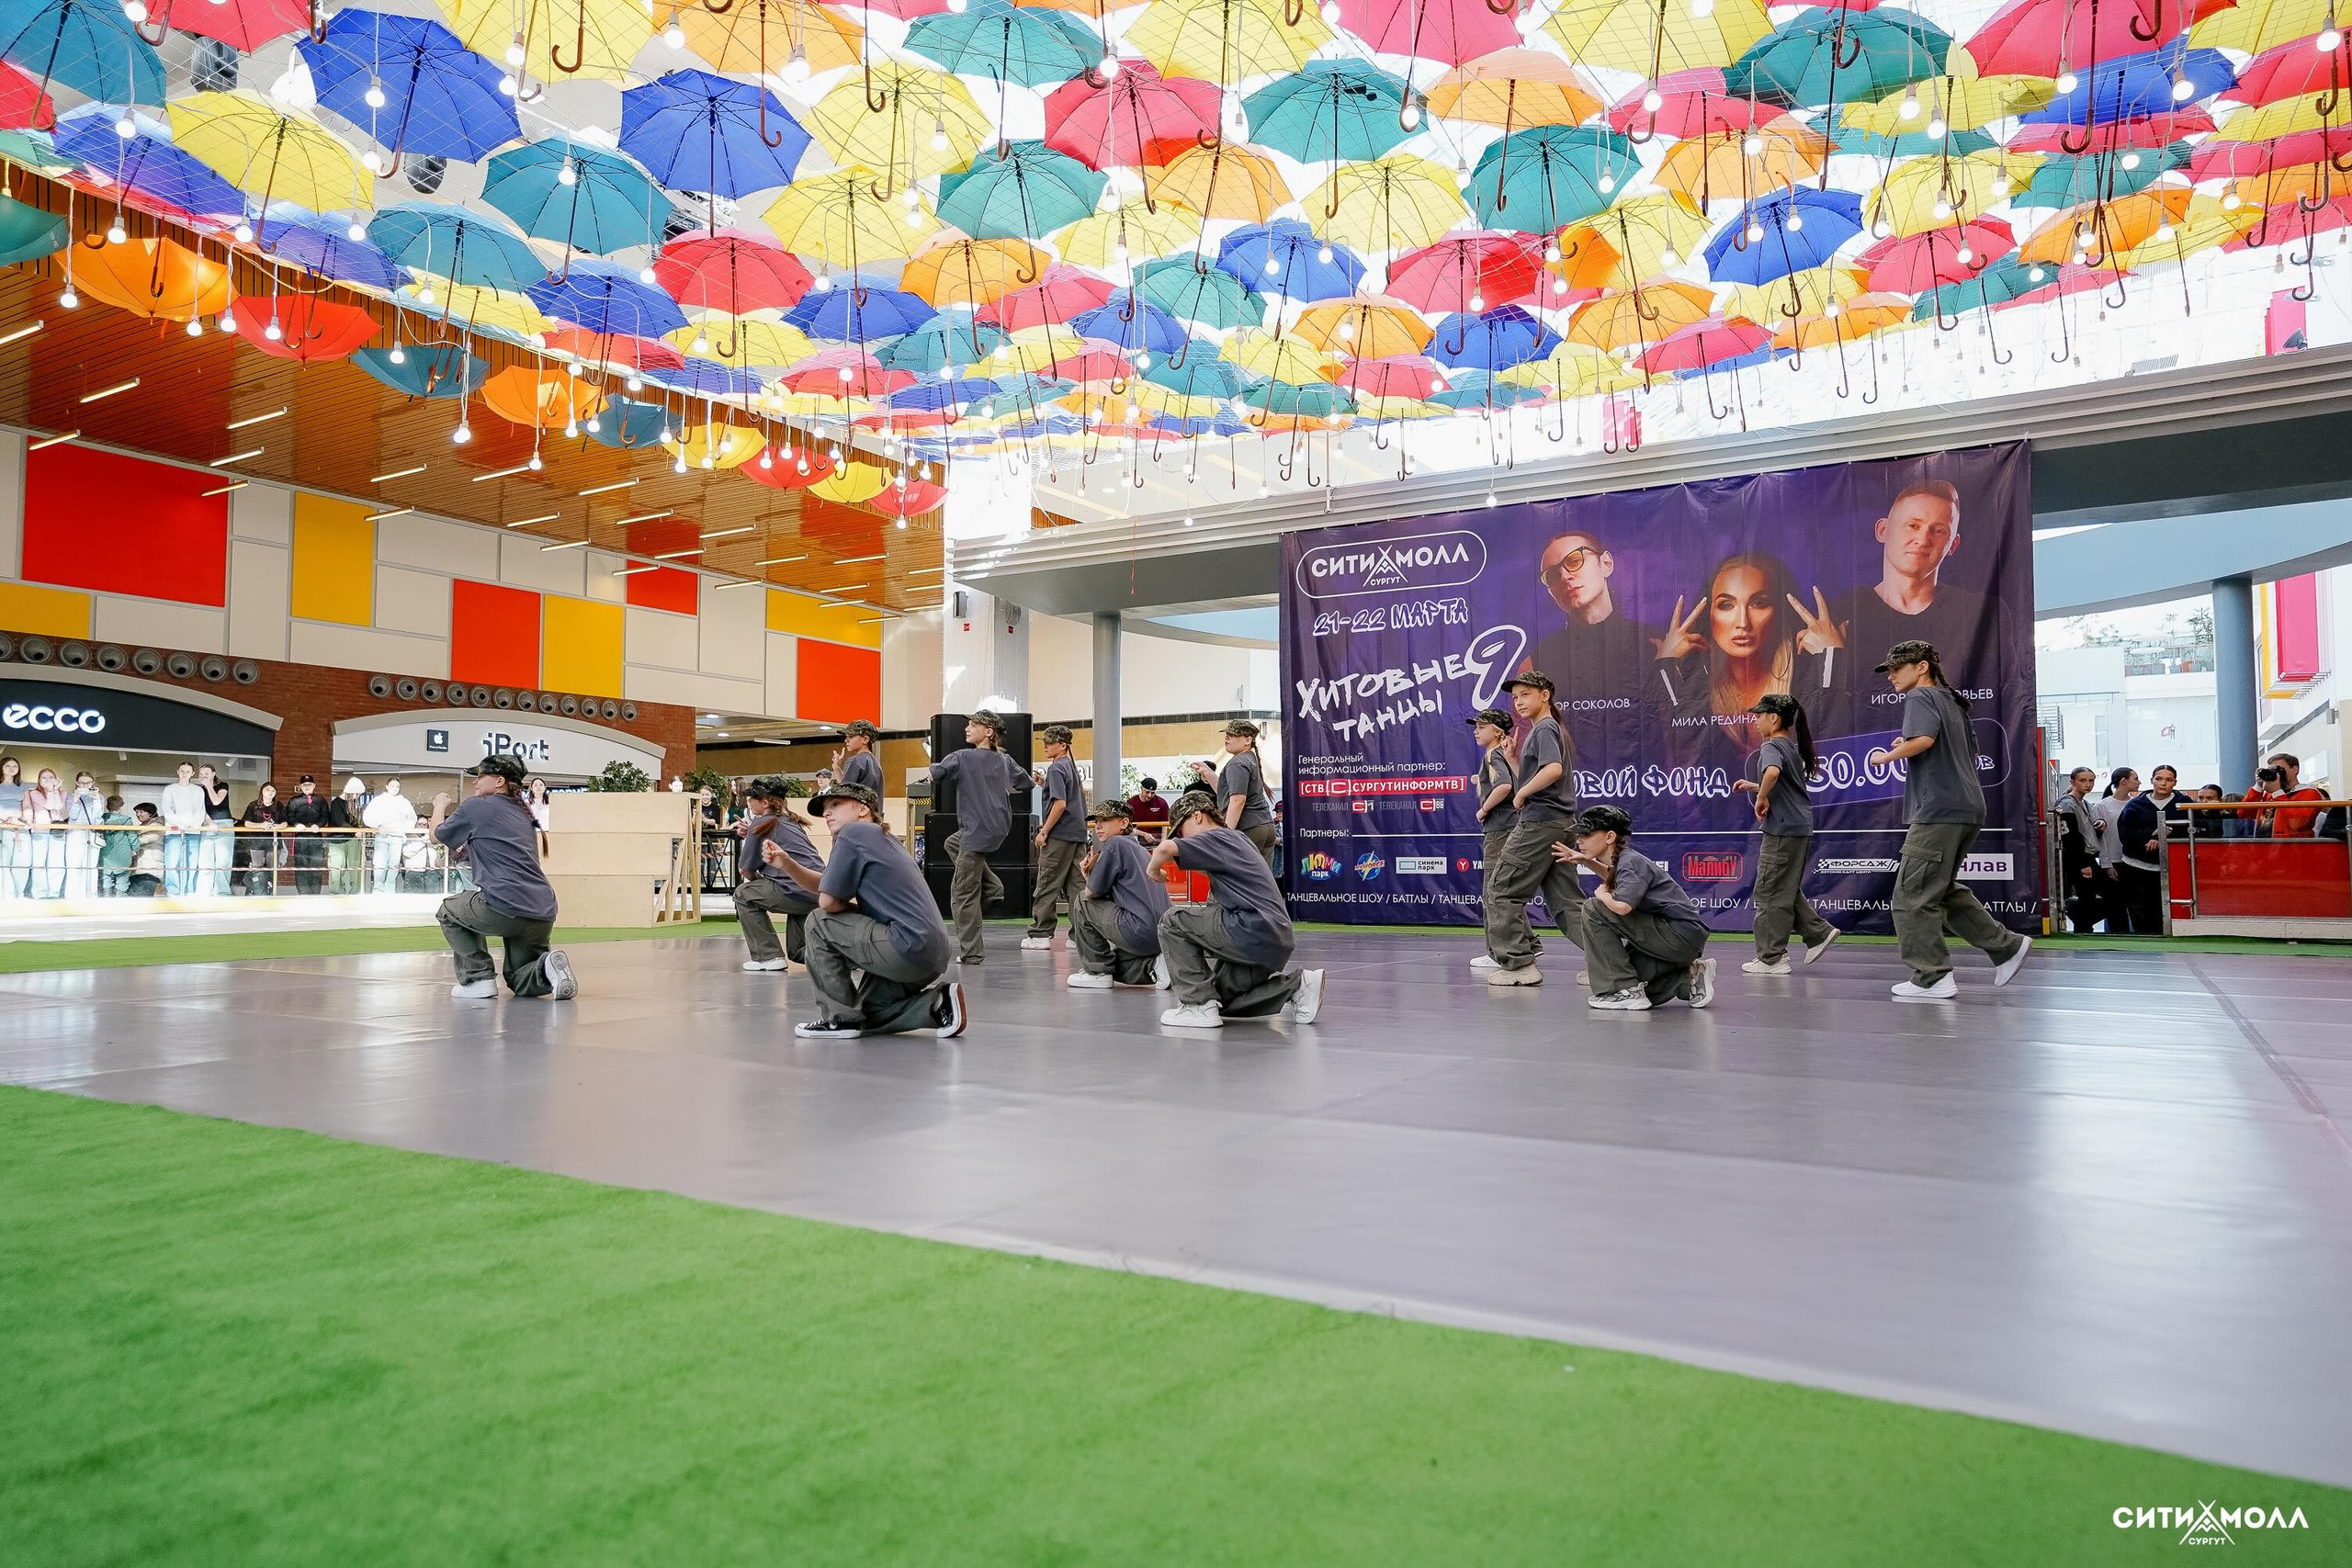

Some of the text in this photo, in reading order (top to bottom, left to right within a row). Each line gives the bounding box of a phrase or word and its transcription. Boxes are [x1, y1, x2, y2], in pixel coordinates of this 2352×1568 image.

[1311, 542, 1470, 578] СИТИ МОЛЛ
[1370, 575, 1401, 586] СУРГУТ
[1312, 597, 1469, 637] 21-22 МАРТА
[1295, 653, 1469, 722] ХИТОВЫЕ
[1555, 697, 1631, 711] ОР СОКОЛОВ
[1871, 694, 1906, 705] ИГОР
[3, 703, 107, 734] ecco
[1333, 689, 1443, 742] ТАНЦЫ
[1671, 713, 1758, 728] МИЛА РЕДИНА
[482, 732, 549, 761] iPort
[1298, 752, 1363, 764] Генеральный
[1298, 761, 1446, 776] информационный партнер:
[1642, 764, 1731, 798] ФОНД
[1312, 802, 1349, 812] ТЕЛЕКАНАЛ
[1379, 801, 1417, 811] ТЕЛЕКАНАЛ
[1300, 829, 1350, 839] Партнеры:
[1311, 870, 1329, 879] парк
[1287, 892, 1357, 904] ТАНЦЕВАЛЬНОЕ
[1359, 893, 1384, 904] ШОУ
[1392, 894, 1429, 905] БАТТЛЫ
[1439, 895, 1484, 906] ТАНЦЕВА
[1710, 897, 1741, 909] ШОУ
[1812, 898, 1894, 911] ТАНЦЕВАЛЬ
[1984, 901, 2027, 913] АТТЛЫ
